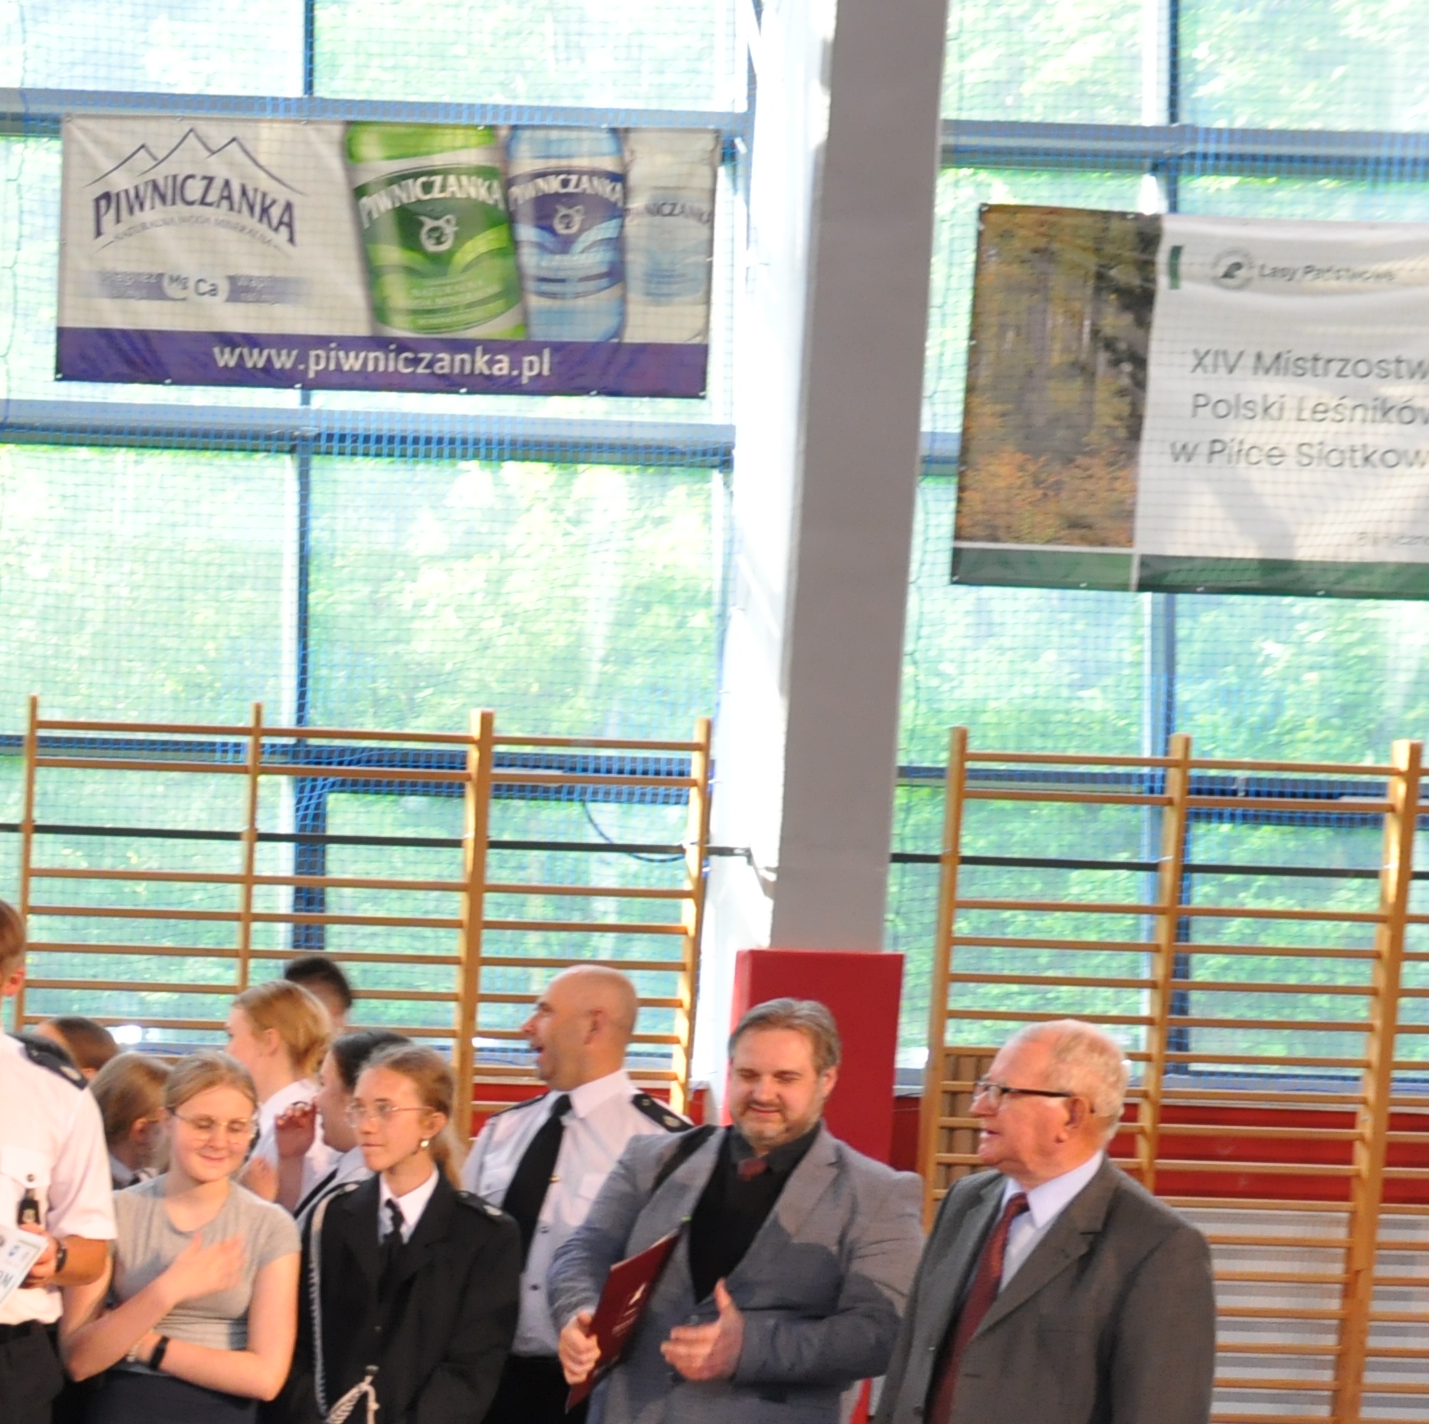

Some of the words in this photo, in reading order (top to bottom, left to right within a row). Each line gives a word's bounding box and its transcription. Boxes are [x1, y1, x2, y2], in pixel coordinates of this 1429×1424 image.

[93, 174, 297, 247] PIWNICZANKA
[358, 174, 505, 229] PIWNICZANKA
[194, 278, 219, 297] Ca
[213, 342, 551, 384] www.piwniczanka.pl
[1191, 349, 1245, 375] XIV
[1192, 393, 1286, 421] Polski
[1170, 442, 1200, 463] w
[1207, 438, 1286, 465] Piłce
